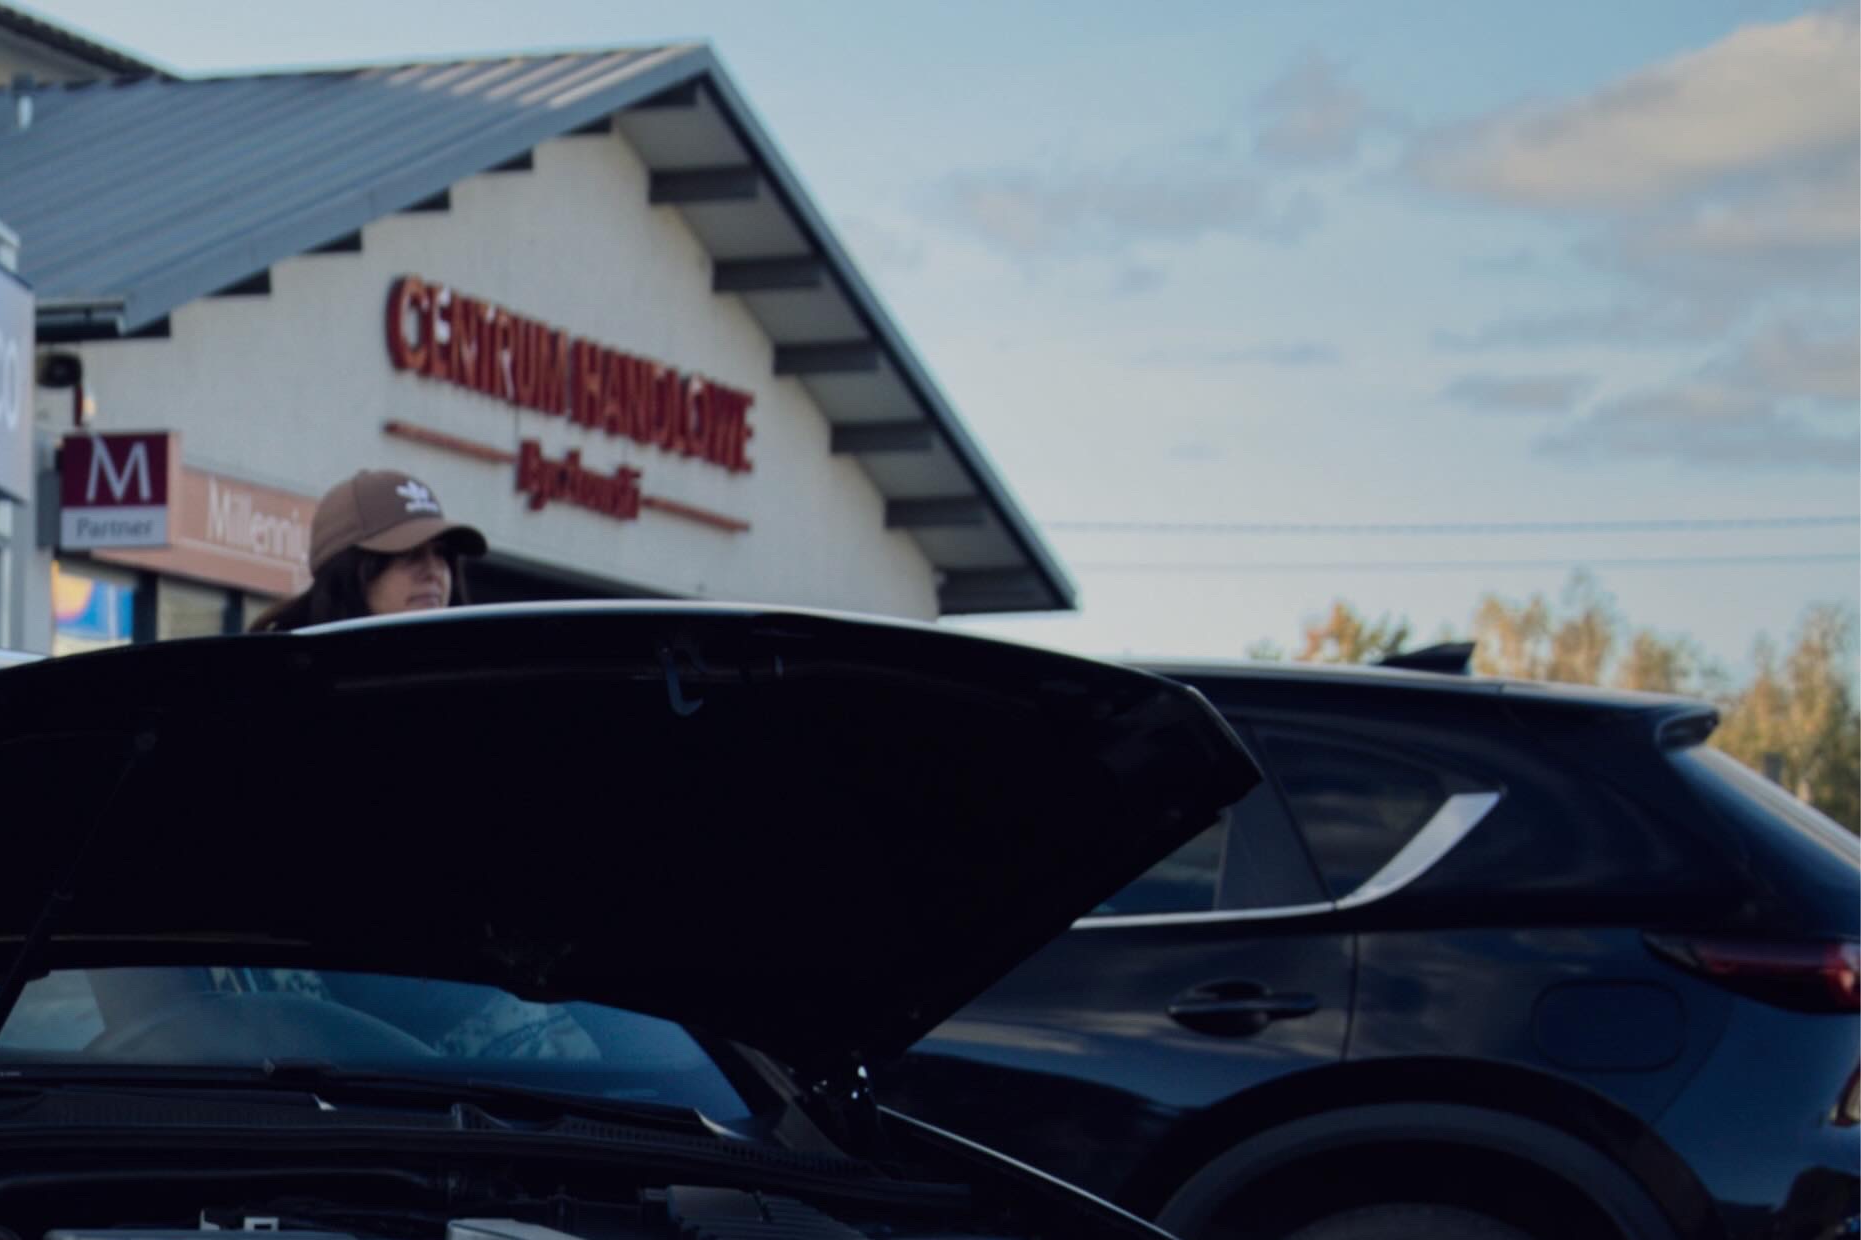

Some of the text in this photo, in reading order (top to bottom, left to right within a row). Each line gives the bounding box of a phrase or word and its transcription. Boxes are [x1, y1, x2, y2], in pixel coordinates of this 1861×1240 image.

[386, 276, 568, 417] CENTRUM
[86, 435, 151, 502] M
[76, 517, 153, 541] Partner
